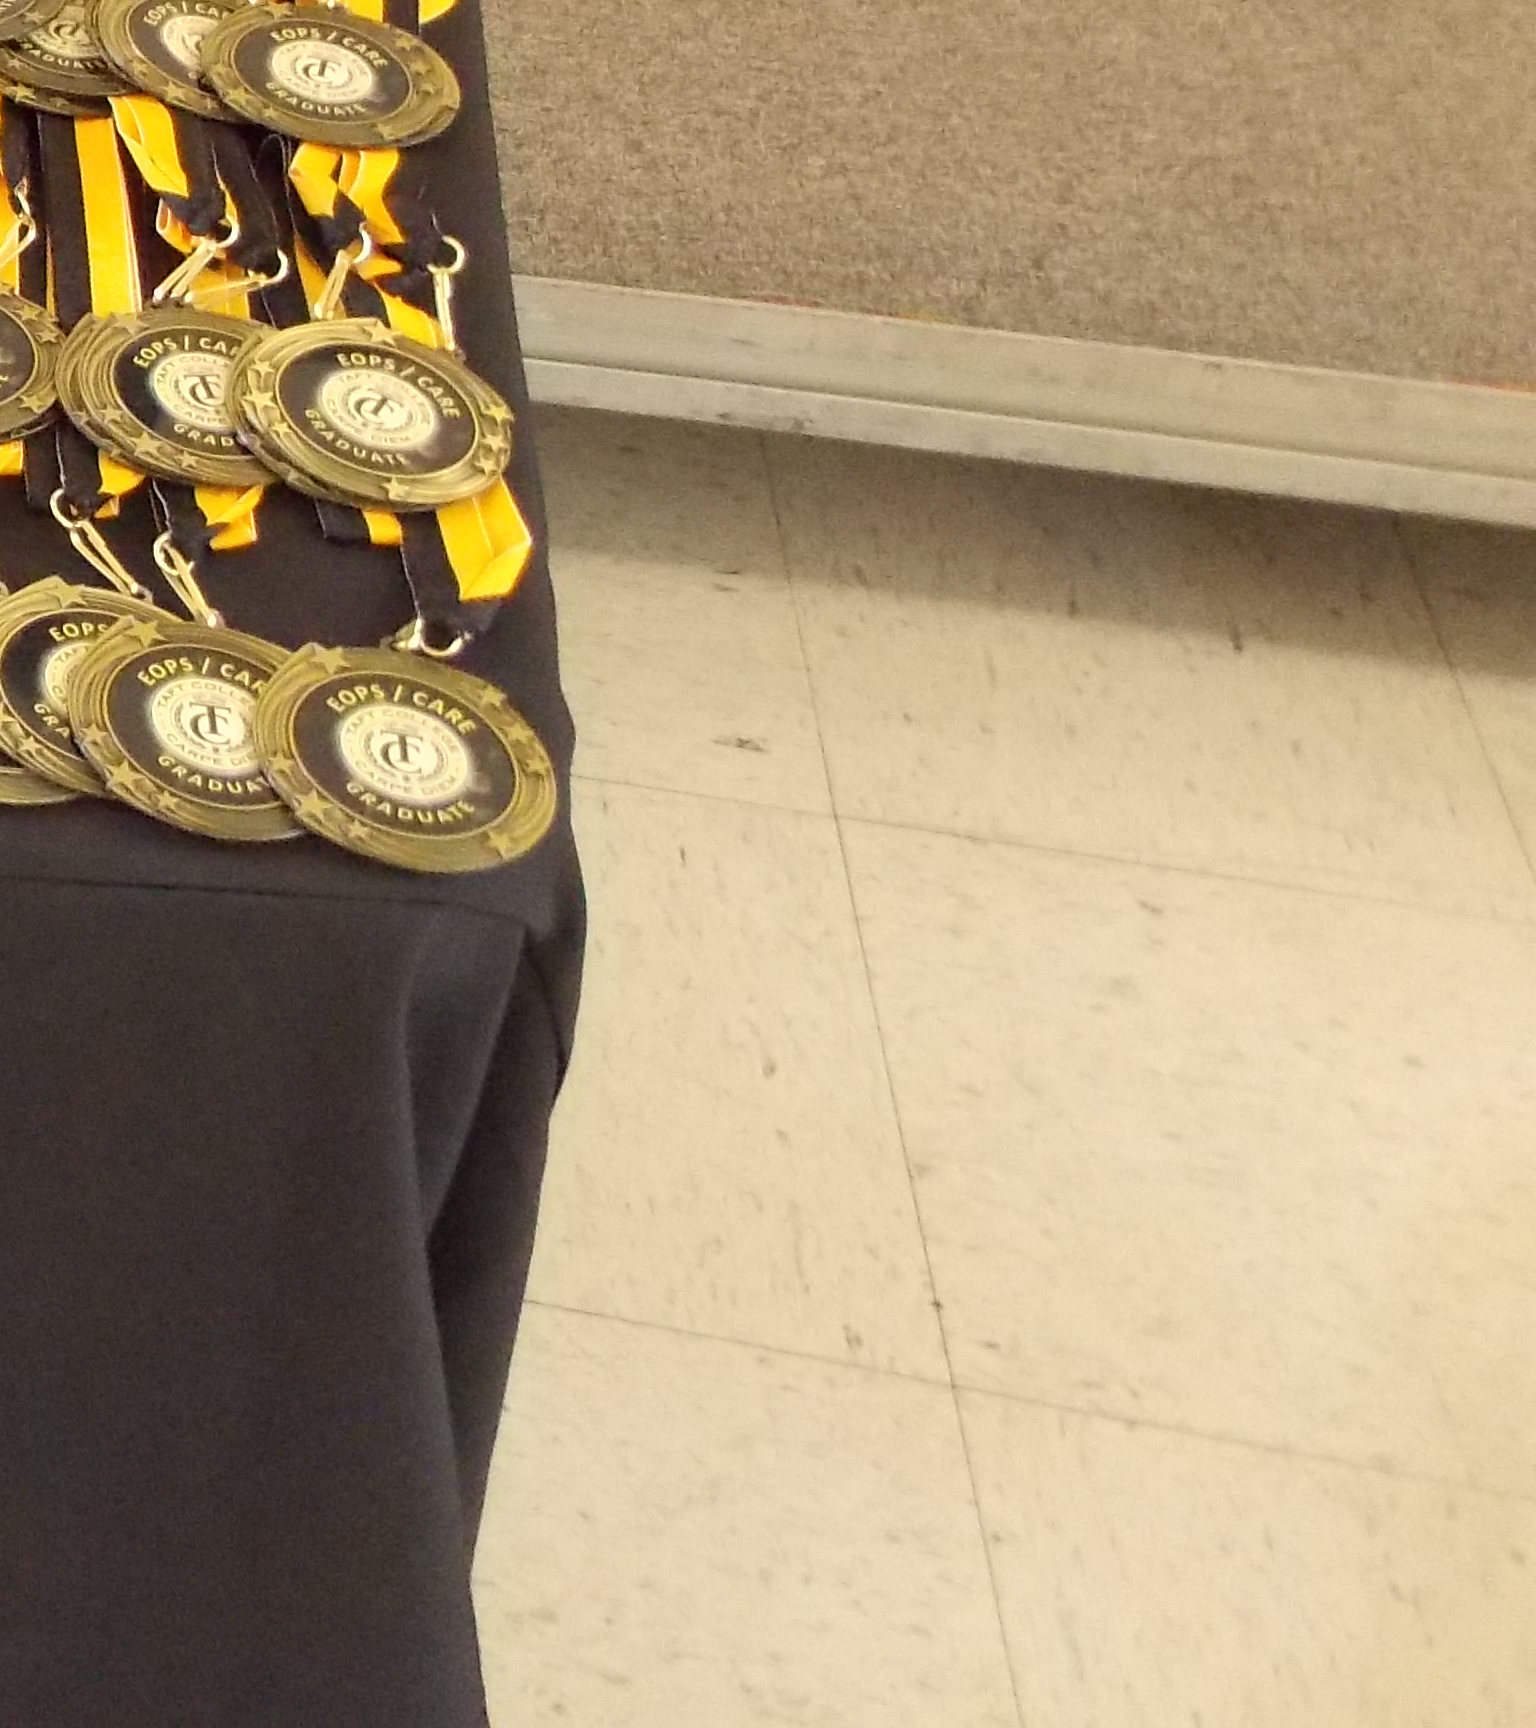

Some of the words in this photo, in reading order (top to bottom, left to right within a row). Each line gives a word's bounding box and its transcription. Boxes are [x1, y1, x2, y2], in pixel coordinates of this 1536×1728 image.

[132, 337, 177, 368] EOPS
[337, 353, 396, 371] EOPS
[417, 376, 461, 418] CARE
[173, 423, 234, 447] GRAD
[305, 410, 411, 465] GRADUATE
[137, 657, 194, 687] EOPS
[326, 684, 386, 713] EOPS
[412, 691, 477, 735] CARE
[346, 783, 475, 824] GRADUATE
